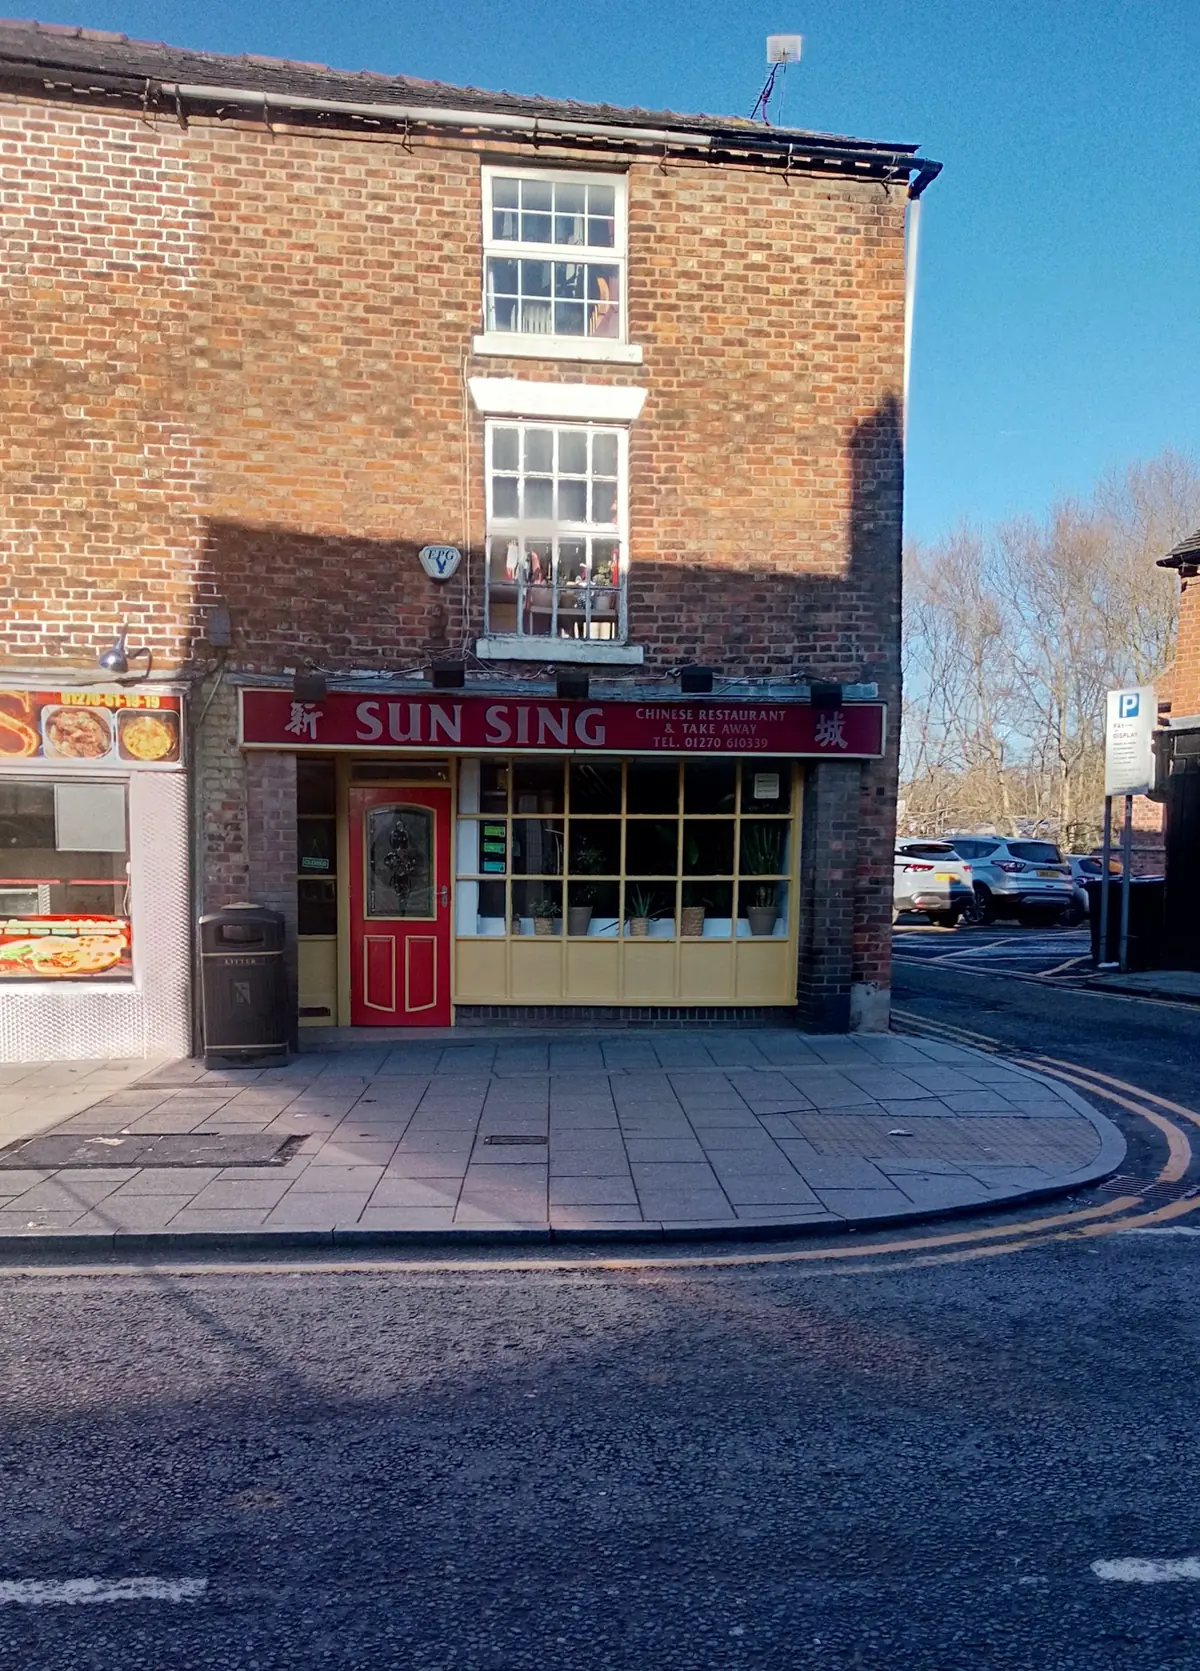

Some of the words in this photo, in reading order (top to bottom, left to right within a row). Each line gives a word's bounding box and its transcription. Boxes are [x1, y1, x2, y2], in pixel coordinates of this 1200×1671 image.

[635, 708, 694, 720] CHINESE
[699, 709, 786, 721] RESTAURANT
[1121, 693, 1138, 717] P
[284, 702, 323, 739] 新
[356, 701, 462, 742] SUN
[484, 705, 605, 746] SING
[664, 723, 675, 734] &
[682, 723, 716, 734] TAKE
[721, 723, 757, 735] AWAY
[814, 711, 849, 749] 城
[653, 736, 680, 748] TEL.
[684, 737, 721, 748] 01270
[726, 737, 768, 749] 610339
